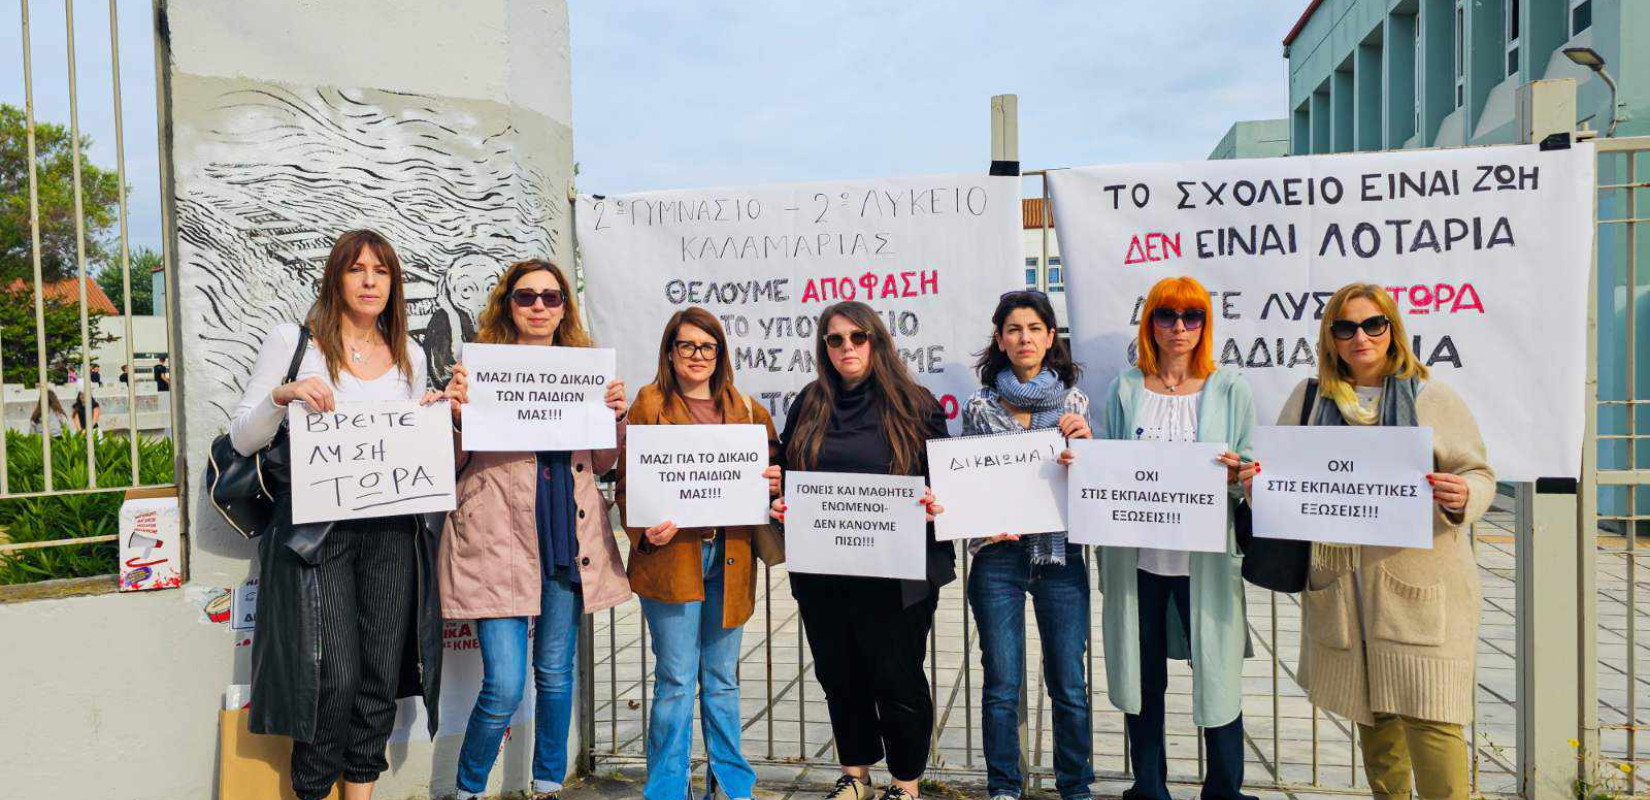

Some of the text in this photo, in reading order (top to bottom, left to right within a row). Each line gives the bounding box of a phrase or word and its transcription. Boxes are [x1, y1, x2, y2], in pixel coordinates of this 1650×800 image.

[1103, 181, 1150, 209] ΤΟ
[1176, 175, 1344, 210] ΣΧΟΛΕΙΟ
[1361, 169, 1459, 201] ΕΙΝΑΙ
[631, 198, 761, 226] ΓΥΜΝΑΣΙΟ
[860, 185, 987, 217] ΛΥΚΕΙΟ
[681, 232, 896, 262] ΚΑΛΑΜΑΡΙΑΣ
[1124, 216, 1515, 265] ΔΕΝ ΕΙΝΑΙ ΛΟΤΑΡΙΑ
[665, 269, 939, 305] ΘΕΛΟΥΜΕ ΑΠΟΦΑΣΗ
[1260, 292, 1332, 321] ΛΥΣ
[476, 371, 605, 386] ΜΑΖΙ ΓΙΑ ΤΟ ΔΙΚΑΙΟ
[496, 390, 585, 403] ΤΩΝ ΠΑΙΔΙΩΝ
[306, 411, 416, 433] ΒΡΕΙΤΕ
[517, 408, 562, 421] ΜΑΣ!!!
[309, 439, 386, 465] ΛΥΣΗ
[640, 451, 759, 465] ΜΑΖΙ ΓΙΑ ΤΟ ΔΙΚΑΙΟ
[1327, 460, 1354, 473] ΟΧΙ
[658, 469, 741, 483] ΤΩΝ ΠΑΙΔΙΩΝ
[1134, 470, 1159, 482] ΟΧΙ
[679, 487, 721, 500] ΜΑΣ!!!
[796, 484, 915, 498] ΓΟΝΕΙΣ ΚΑΙ ΜΑΘΗΤΕΣ
[1267, 479, 1419, 498] ΣΤΙΣ ΕΚΠΑΙΔΕΥΤΙΚΕΣ
[1081, 488, 1215, 505] ΣΤΙΣ ΕΚΠΑΙΔΕΥΤΙΚΕΣ
[822, 501, 889, 513] ΕΝΩΜΕΝΟΙ-
[1301, 502, 1379, 519] ΕΞΩΣΕΙΣ!!!
[1112, 509, 1181, 524] ΕΞΩΣΕΙΣ!!!
[813, 519, 897, 532] ΔΕΝ ΚΑΝΟΥΜΕ
[835, 535, 875, 547] ΠΙΣΩ!!!
